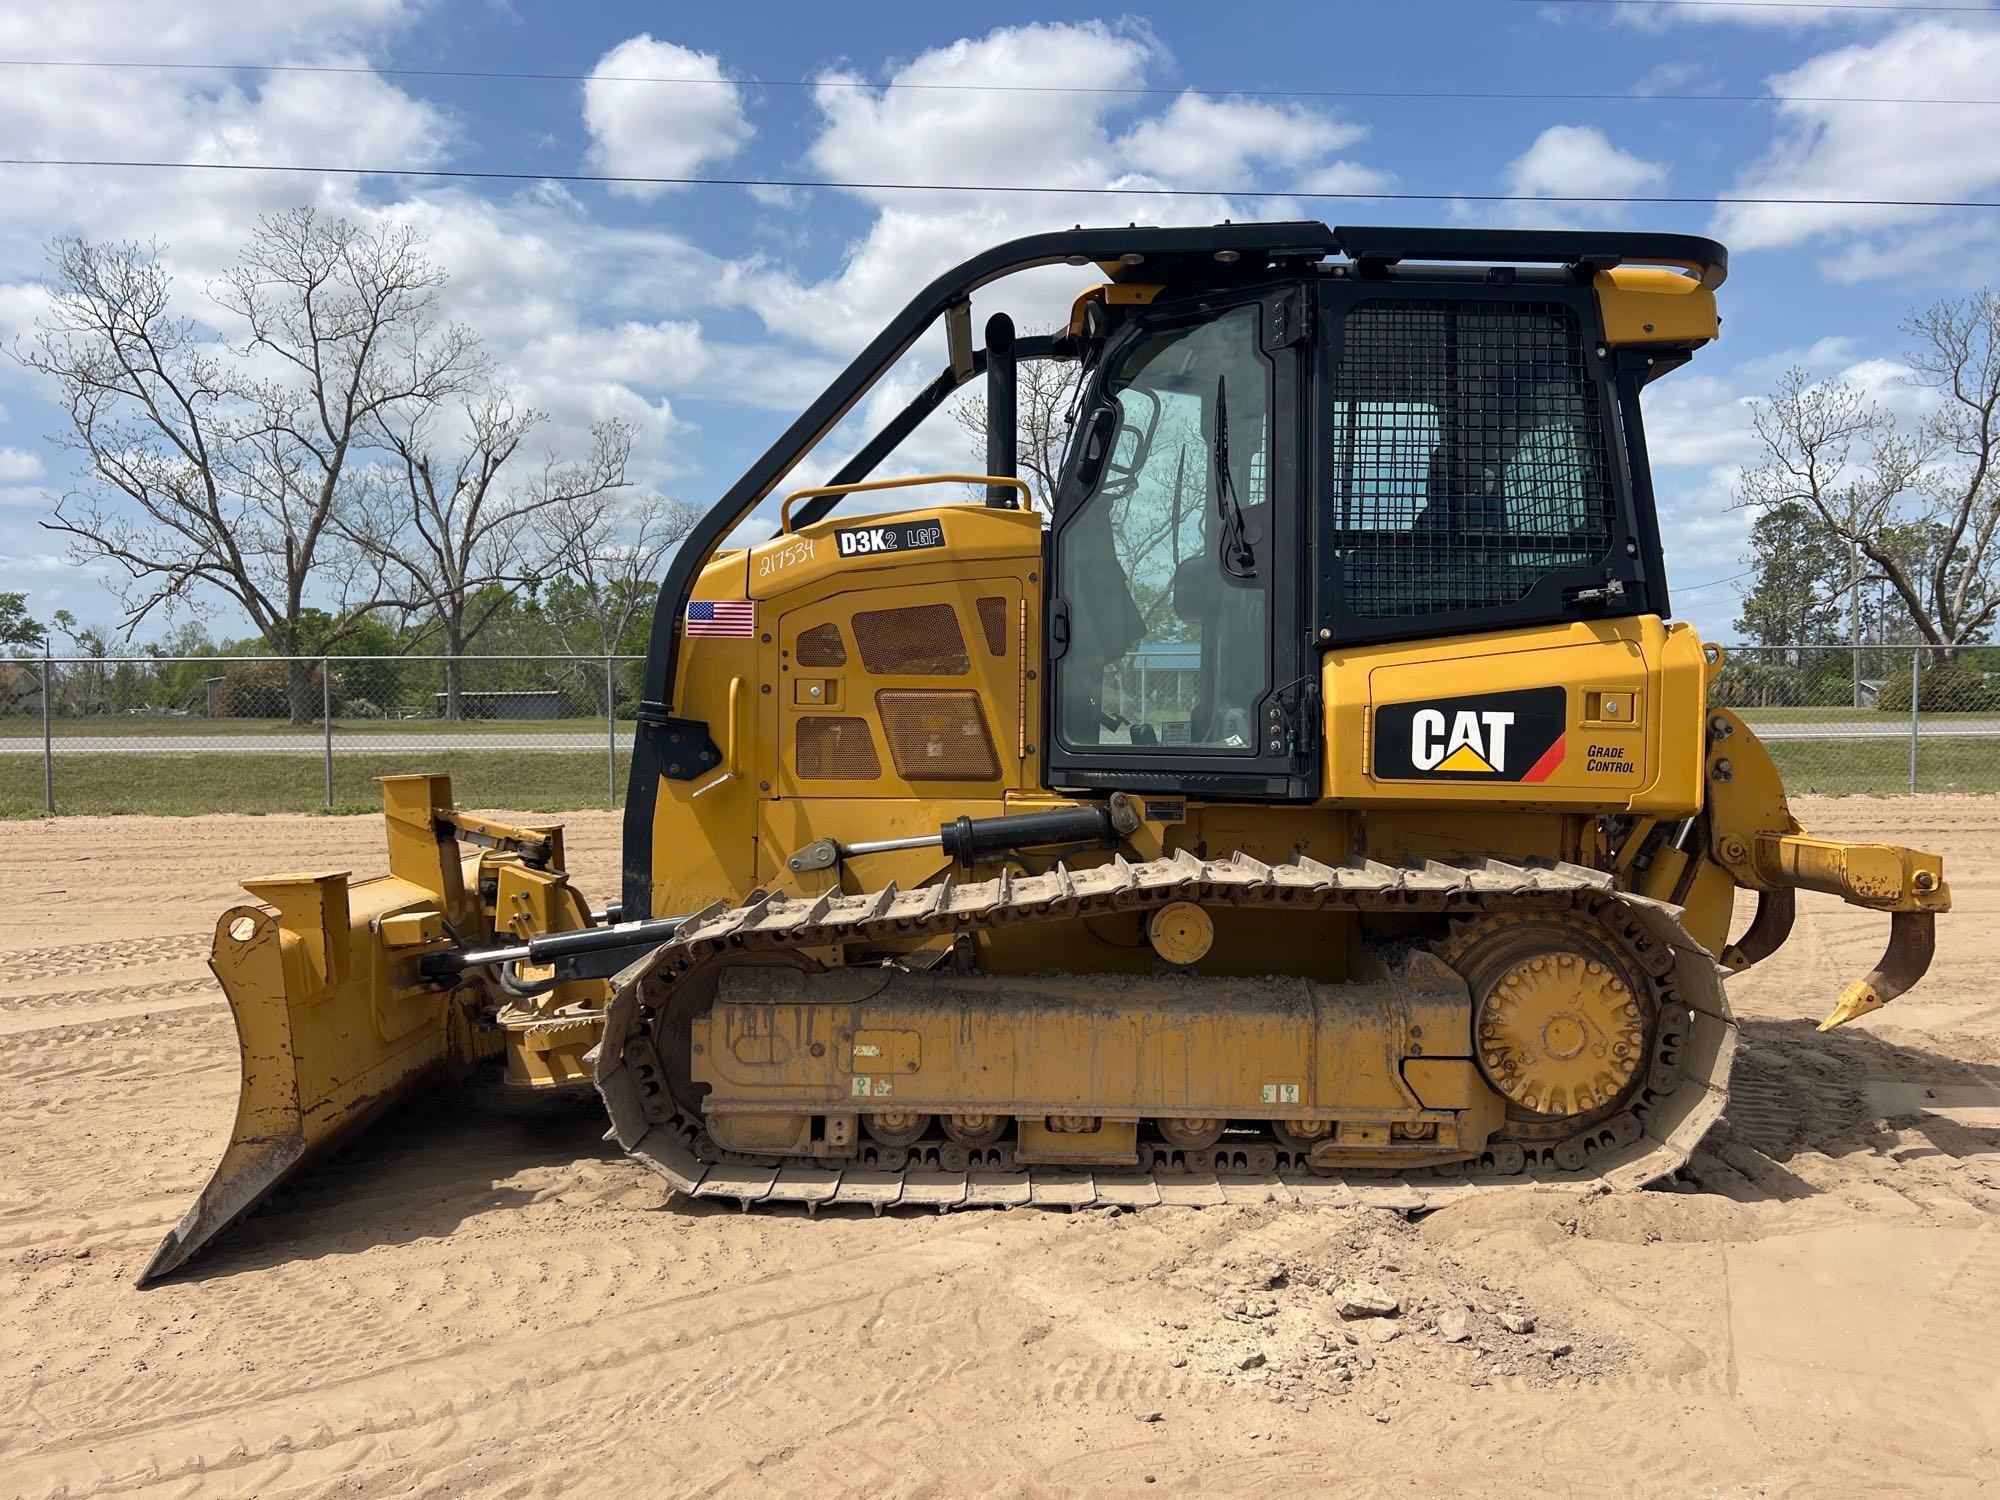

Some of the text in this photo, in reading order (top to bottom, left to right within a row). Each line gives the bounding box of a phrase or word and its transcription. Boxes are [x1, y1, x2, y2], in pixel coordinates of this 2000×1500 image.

[841, 527, 940, 554] D3K2 LGP
[760, 538, 816, 577] 217534
[1412, 709, 1515, 772] CAT
[1587, 744, 1625, 758] GRADE
[1586, 759, 1635, 773] CONTROL
